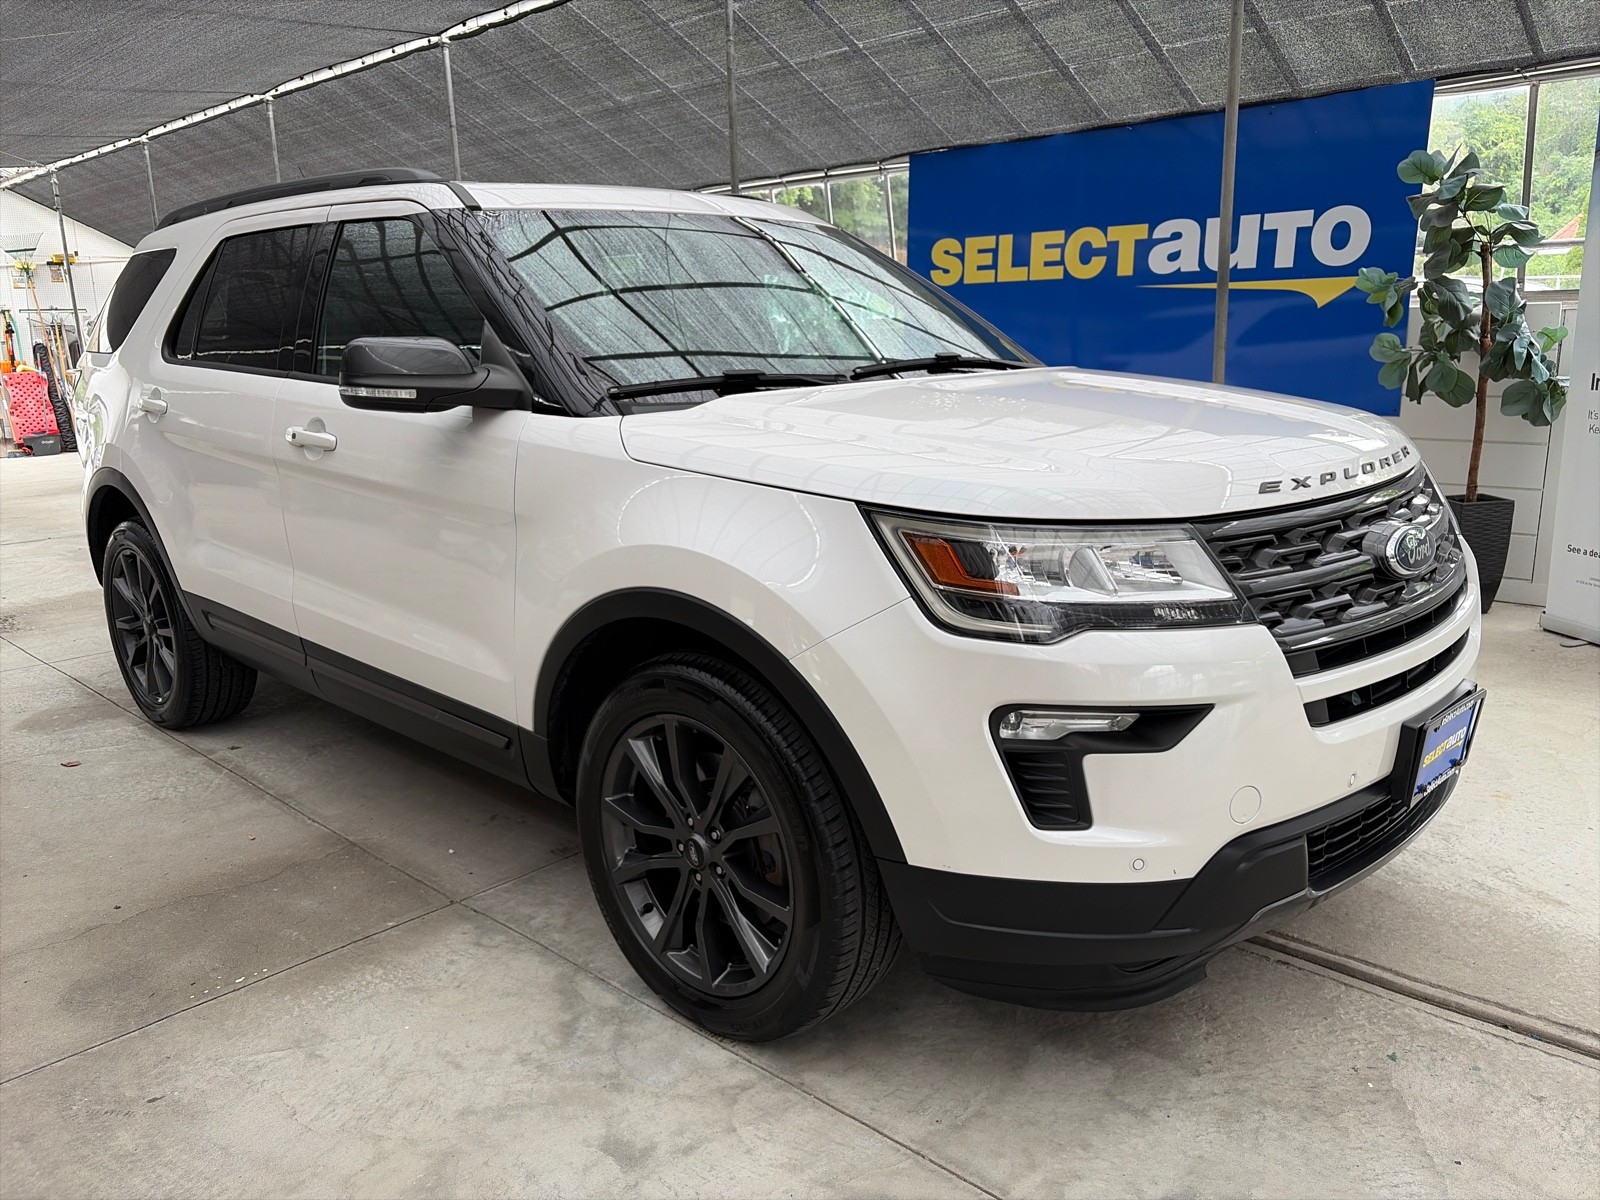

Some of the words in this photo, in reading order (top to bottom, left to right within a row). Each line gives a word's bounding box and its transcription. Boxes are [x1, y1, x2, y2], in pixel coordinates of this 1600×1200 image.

[1258, 445, 1410, 495] EXPLORER
[1406, 535, 1432, 565] Ford
[1567, 544, 1581, 554] See
